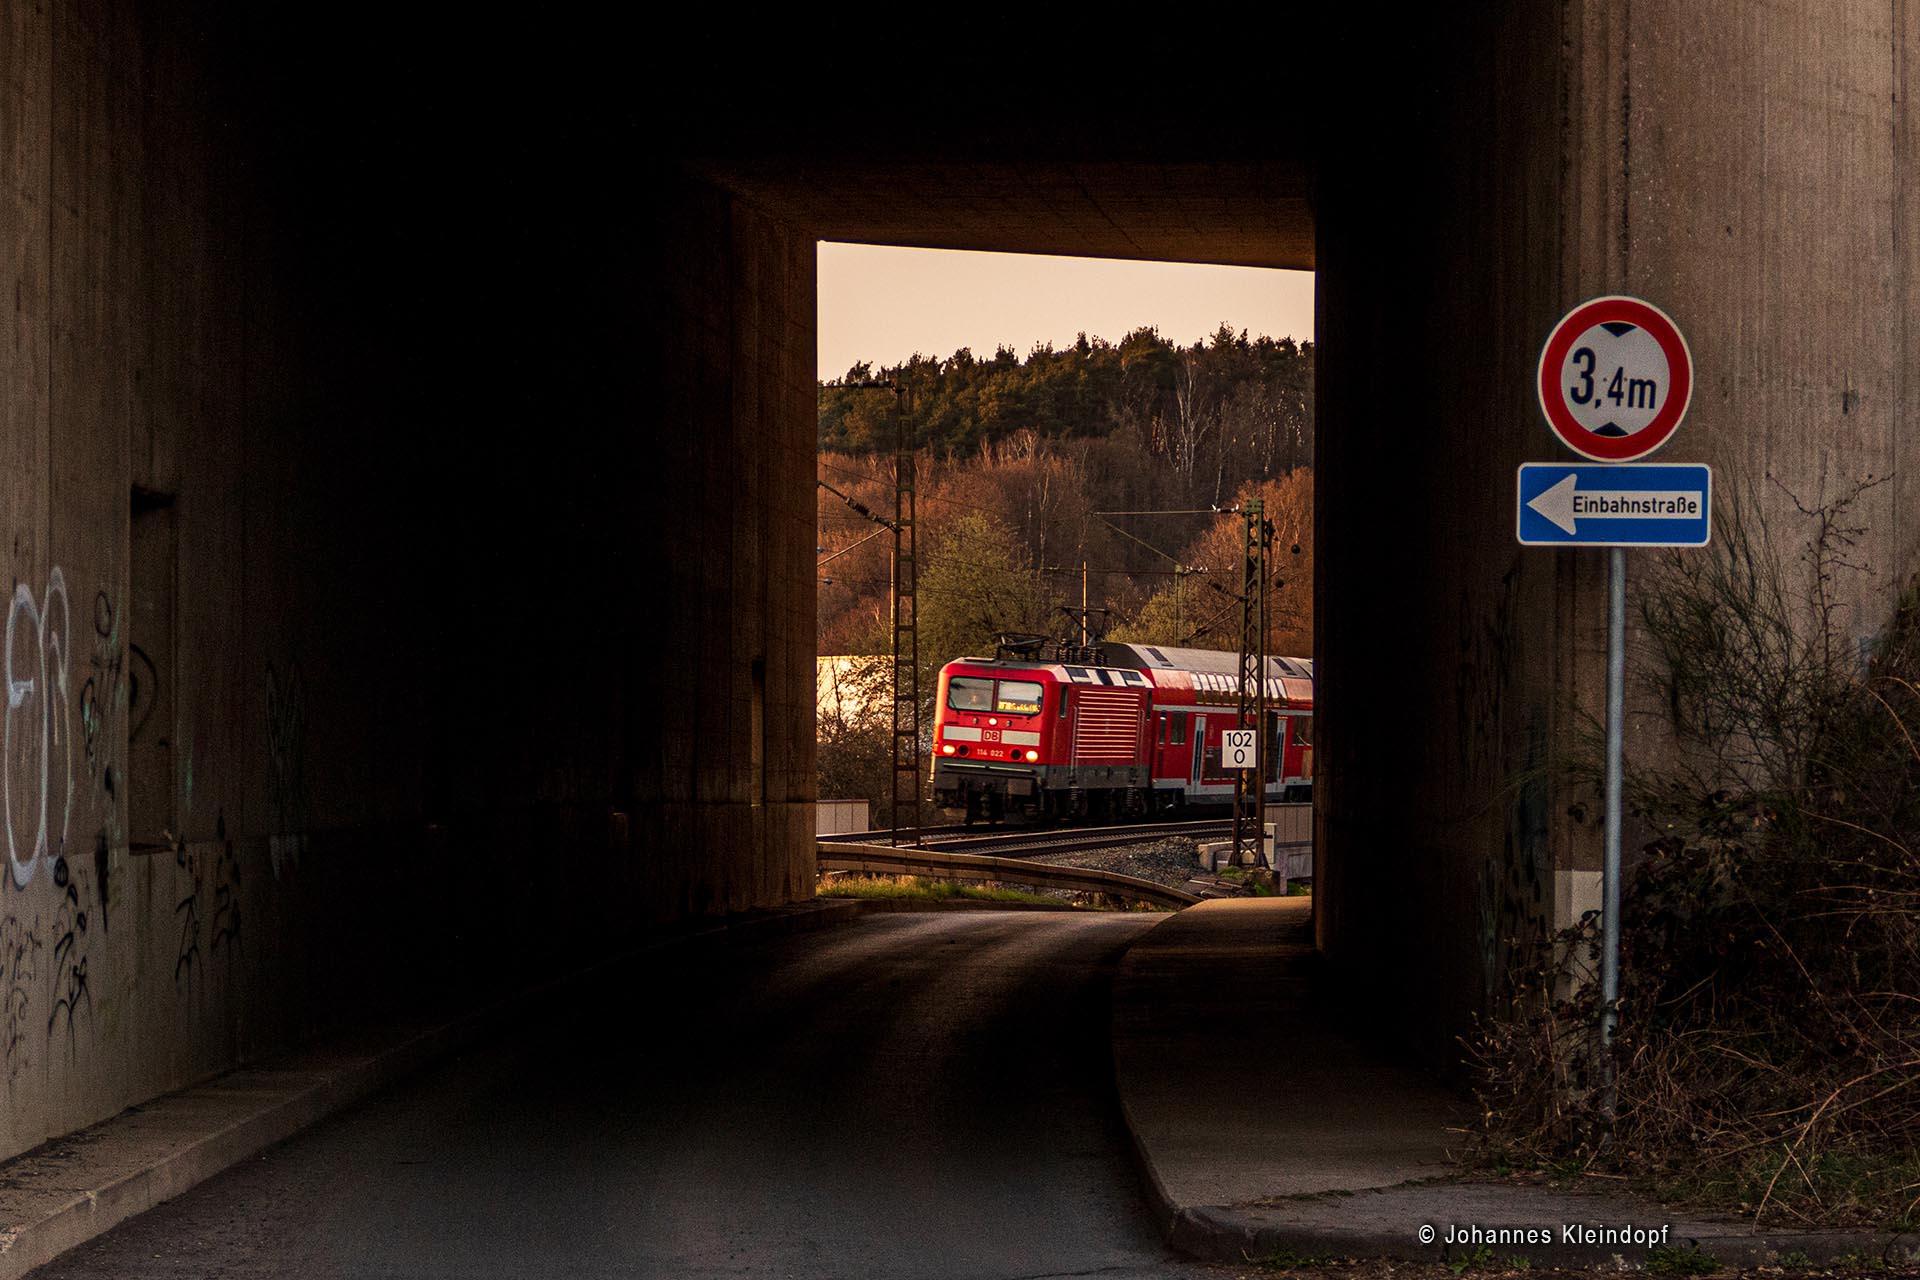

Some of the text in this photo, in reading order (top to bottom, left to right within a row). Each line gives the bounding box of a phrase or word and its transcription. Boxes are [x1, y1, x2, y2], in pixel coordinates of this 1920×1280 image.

[1573, 496, 1697, 514] Einbahnstraße
[984, 731, 999, 741] DB
[1226, 732, 1252, 748] 102
[990, 749, 1004, 757] 022
[1234, 749, 1245, 764] 0
